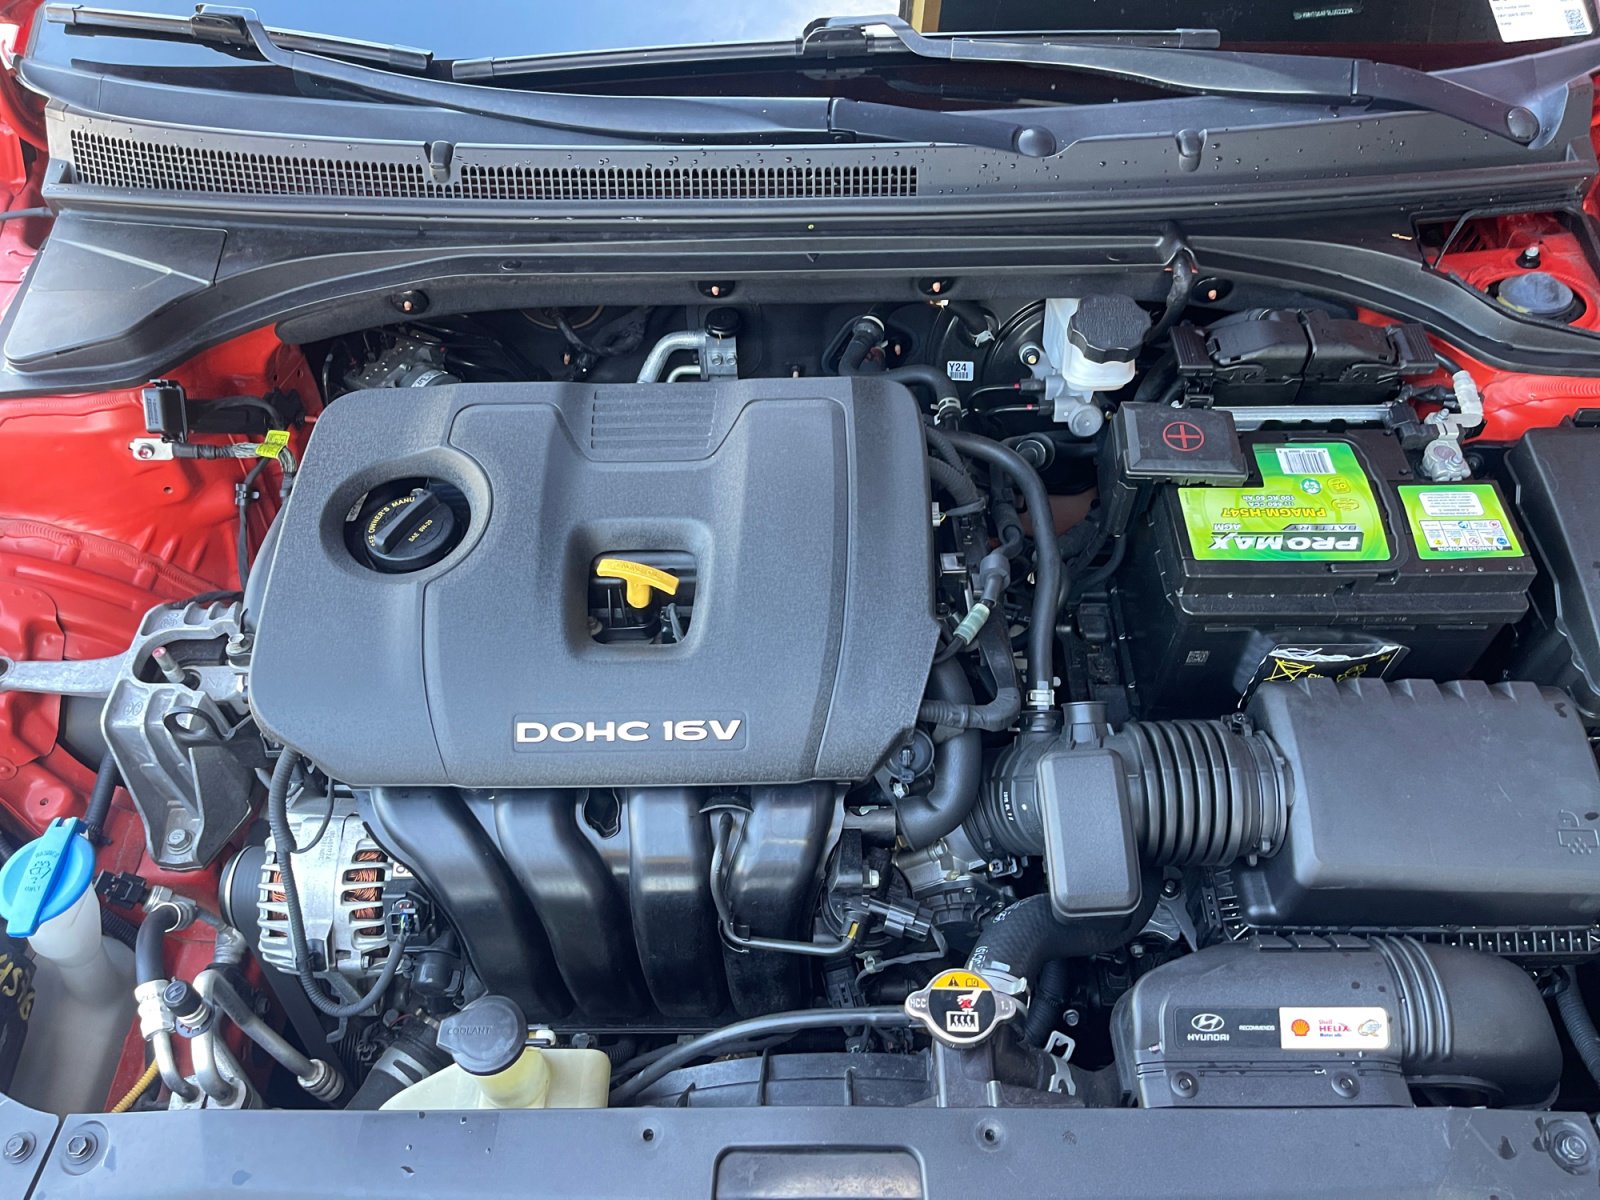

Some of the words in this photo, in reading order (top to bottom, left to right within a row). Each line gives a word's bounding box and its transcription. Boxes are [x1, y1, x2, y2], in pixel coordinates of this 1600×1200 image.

[949, 362, 967, 372] Y24
[367, 506, 390, 534] OWNER'S
[391, 496, 416, 508] MANU
[1220, 507, 1327, 518] PMAGM-H547
[1213, 522, 1241, 531] AGM
[516, 721, 650, 743] DOHC
[662, 720, 742, 741] 16V
[909, 998, 927, 1009] HCC
[447, 1025, 493, 1036] COOLANT
[1319, 1024, 1350, 1033] HELIX
[1186, 1033, 1231, 1042] HYUNDAI
